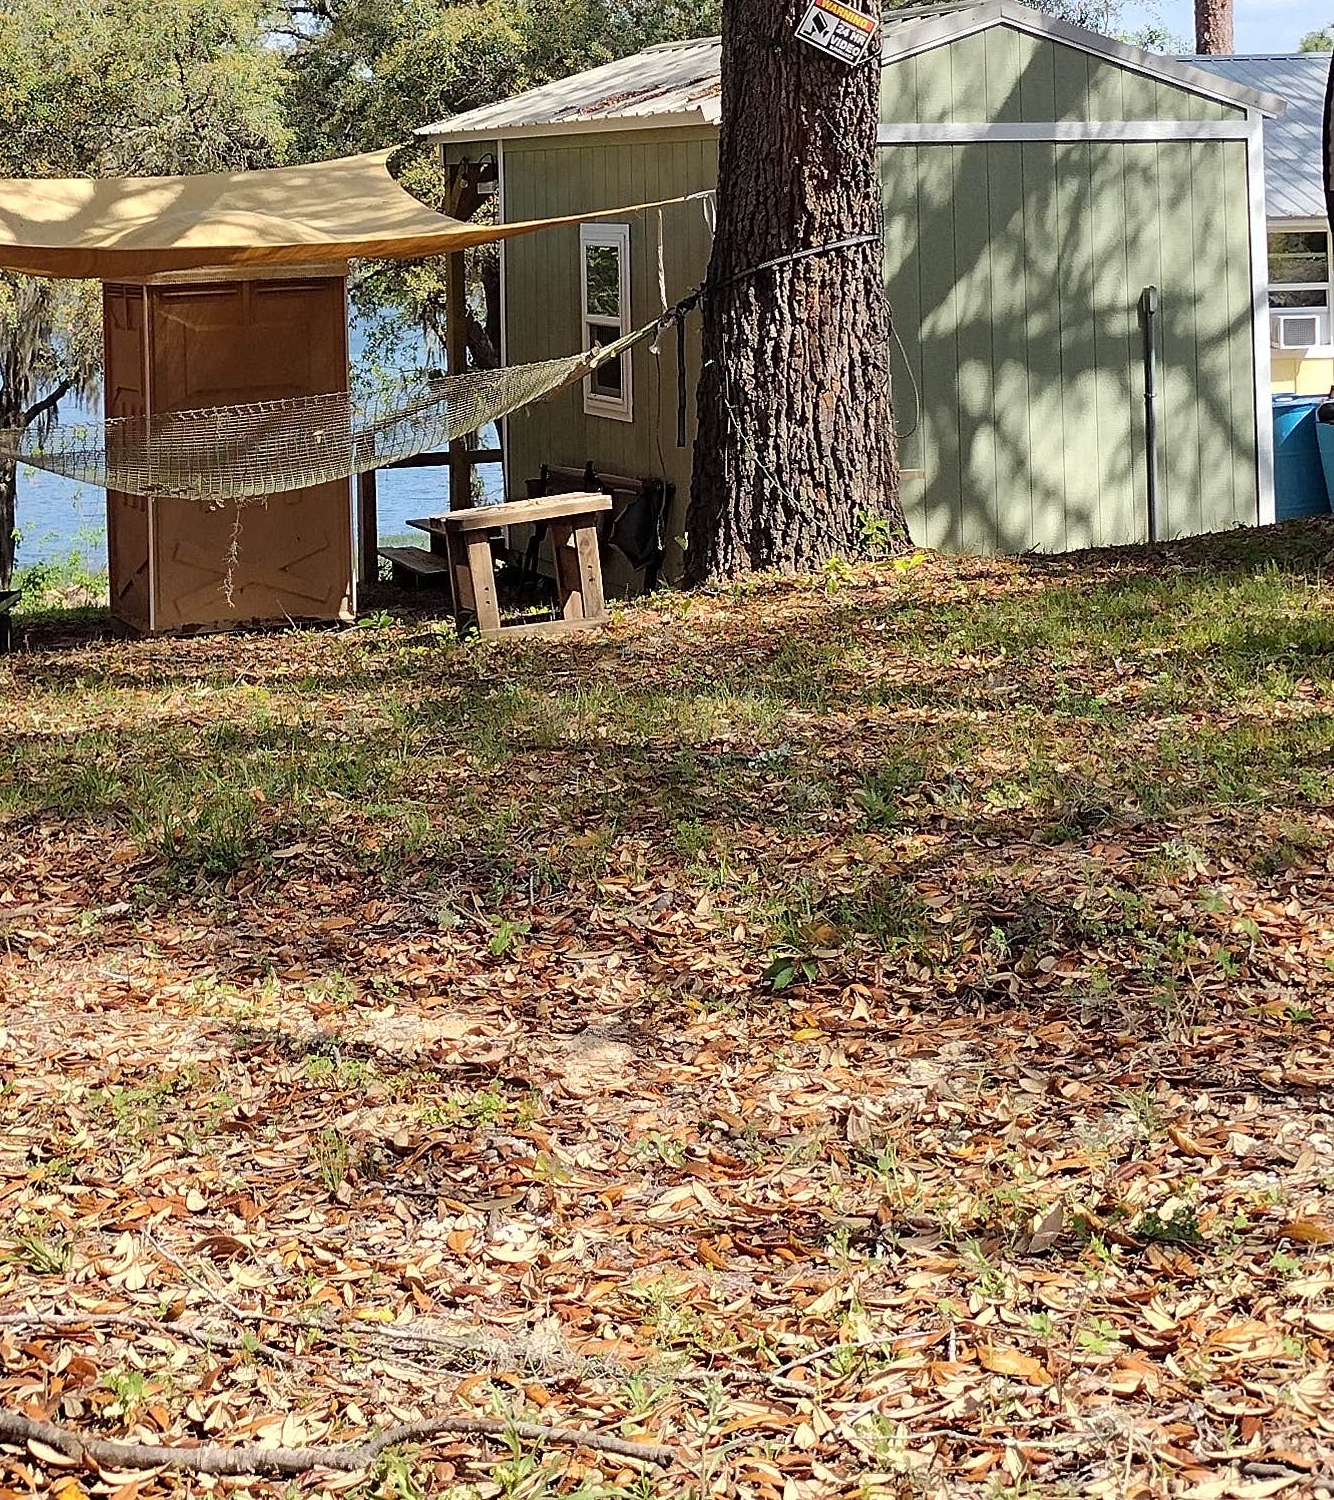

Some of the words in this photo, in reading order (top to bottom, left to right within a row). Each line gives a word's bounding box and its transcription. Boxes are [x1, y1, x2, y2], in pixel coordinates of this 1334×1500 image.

[830, 34, 861, 57] VIDEO
[835, 24, 850, 37] 24
[849, 31, 866, 46] HR
